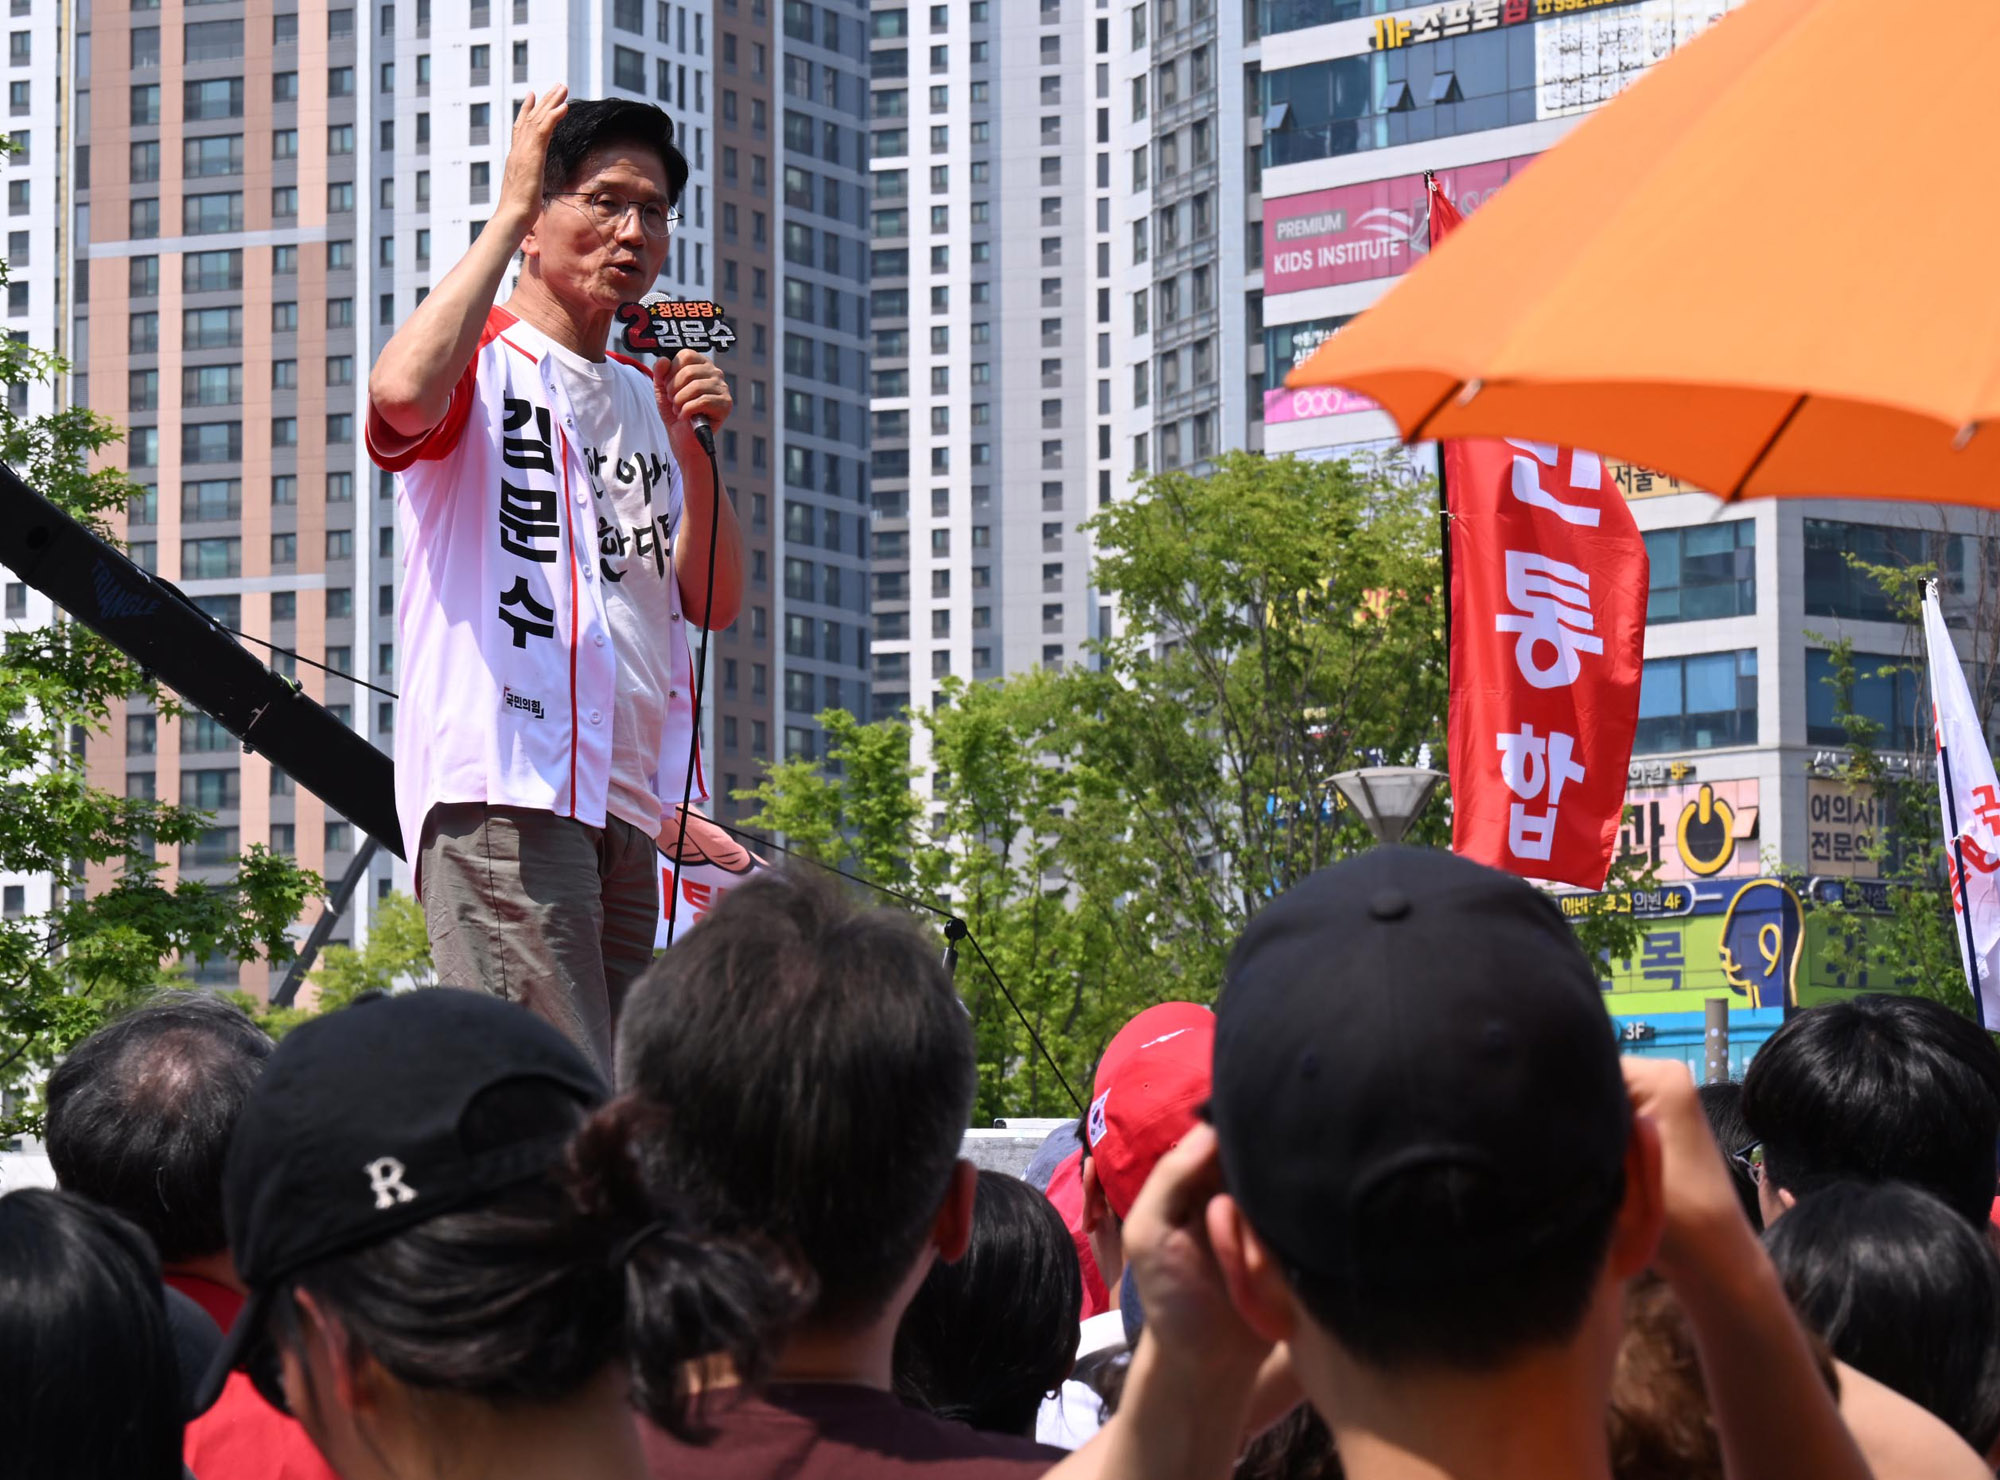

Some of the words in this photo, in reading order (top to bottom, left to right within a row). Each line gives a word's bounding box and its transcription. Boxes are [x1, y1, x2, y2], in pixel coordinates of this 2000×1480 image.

[1374, 16, 1412, 50] 11F
[1276, 212, 1342, 240] PREMIUM
[1273, 249, 1313, 275] KIDS
[1317, 236, 1400, 268] INSTITUTE
[656, 302, 714, 318] 정정당당
[621, 305, 658, 348] 2
[652, 319, 736, 348] 김문수
[499, 390, 560, 649] 김문수
[504, 691, 542, 716] 국민의힘
[1810, 793, 1875, 826] 여의사
[1810, 832, 1875, 862] 전문의
[1633, 890, 1662, 912] 의원
[1664, 891, 1682, 910] 4F
[1625, 1021, 1646, 1040] 3F
[363, 1156, 418, 1209] R
